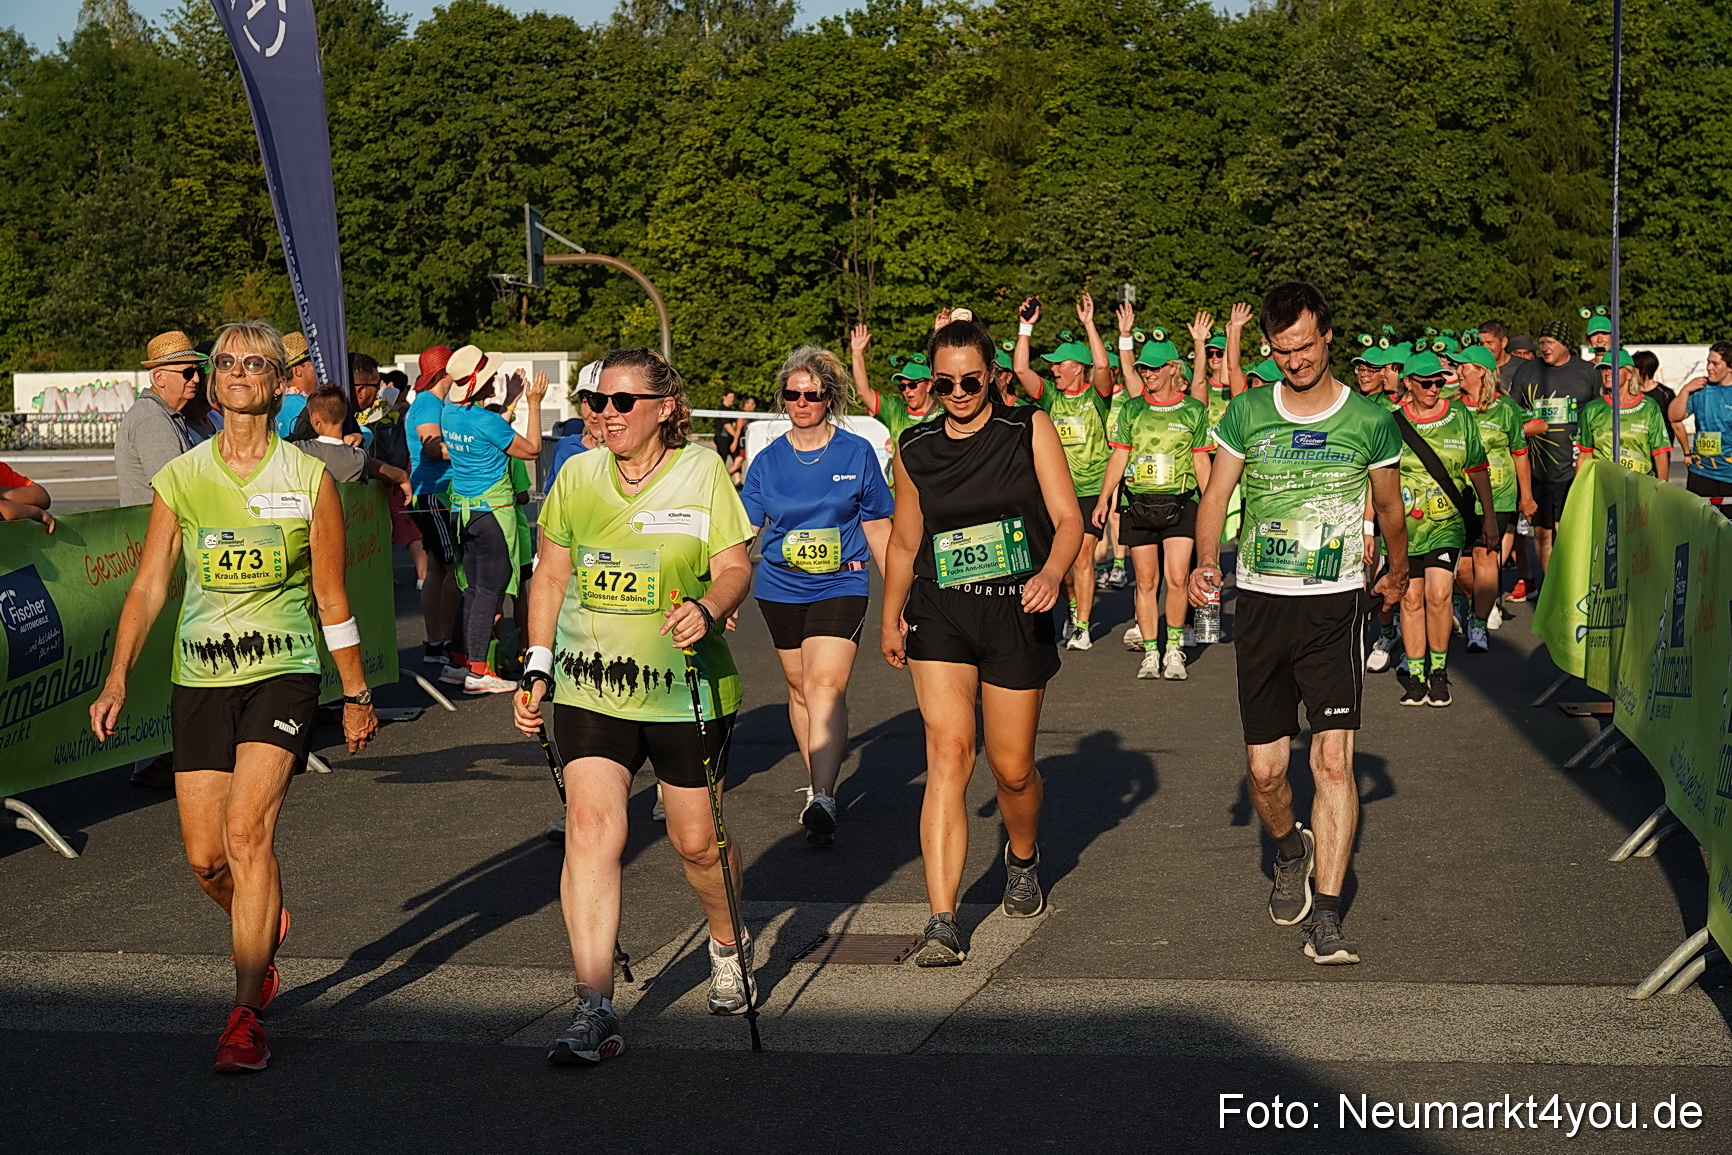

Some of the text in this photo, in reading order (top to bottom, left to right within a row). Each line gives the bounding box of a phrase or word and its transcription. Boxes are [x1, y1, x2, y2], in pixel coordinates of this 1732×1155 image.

[1541, 407, 1559, 417] 852
[1699, 440, 1716, 448] 1902
[1273, 445, 1358, 464] firmenlauf
[1620, 458, 1634, 469] 96
[1251, 469, 1348, 480] Gesunde Firmen
[1269, 481, 1305, 491] laufen
[797, 544, 828, 559] 439
[951, 544, 989, 568] 263
[995, 543, 1007, 569] 2022
[1265, 537, 1300, 558] 304
[84, 532, 143, 587] Gesunde
[202, 553, 211, 582] WALK
[218, 549, 263, 570] 473
[273, 550, 282, 578] 2022
[940, 558, 948, 577] RUN
[946, 566, 965, 576] Fuchs
[964, 561, 999, 573] Ann-Kristin
[1275, 558, 1308, 567] Sebastian
[214, 571, 270, 580] Krauß Beatrix
[594, 570, 637, 592] 472
[588, 591, 647, 602] Glossner Sabine
[647, 576, 655, 605] 2022
[998, 584, 1024, 596] UND
[8, 599, 46, 625] Fischer
[20, 614, 49, 634] AUTOMOBILE
[1333, 707, 1350, 715] JAKO
[273, 719, 296, 736] PUMA
